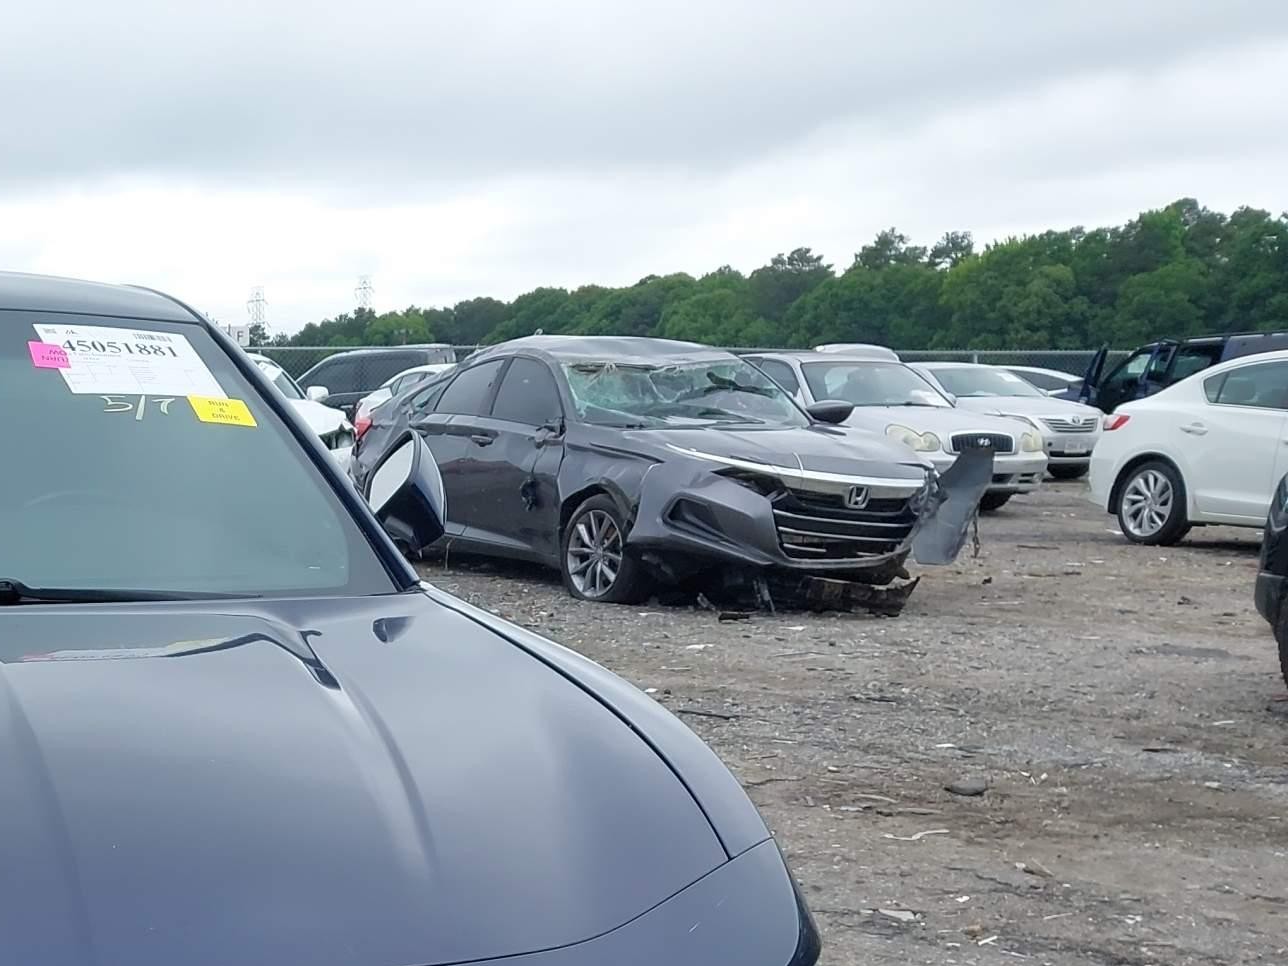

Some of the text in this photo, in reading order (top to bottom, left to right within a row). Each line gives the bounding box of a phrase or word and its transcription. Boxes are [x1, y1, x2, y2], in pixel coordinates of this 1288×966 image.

[62, 339, 178, 358] 45051881
[100, 395, 176, 421] 5/7
[211, 413, 241, 421] DRIVE
